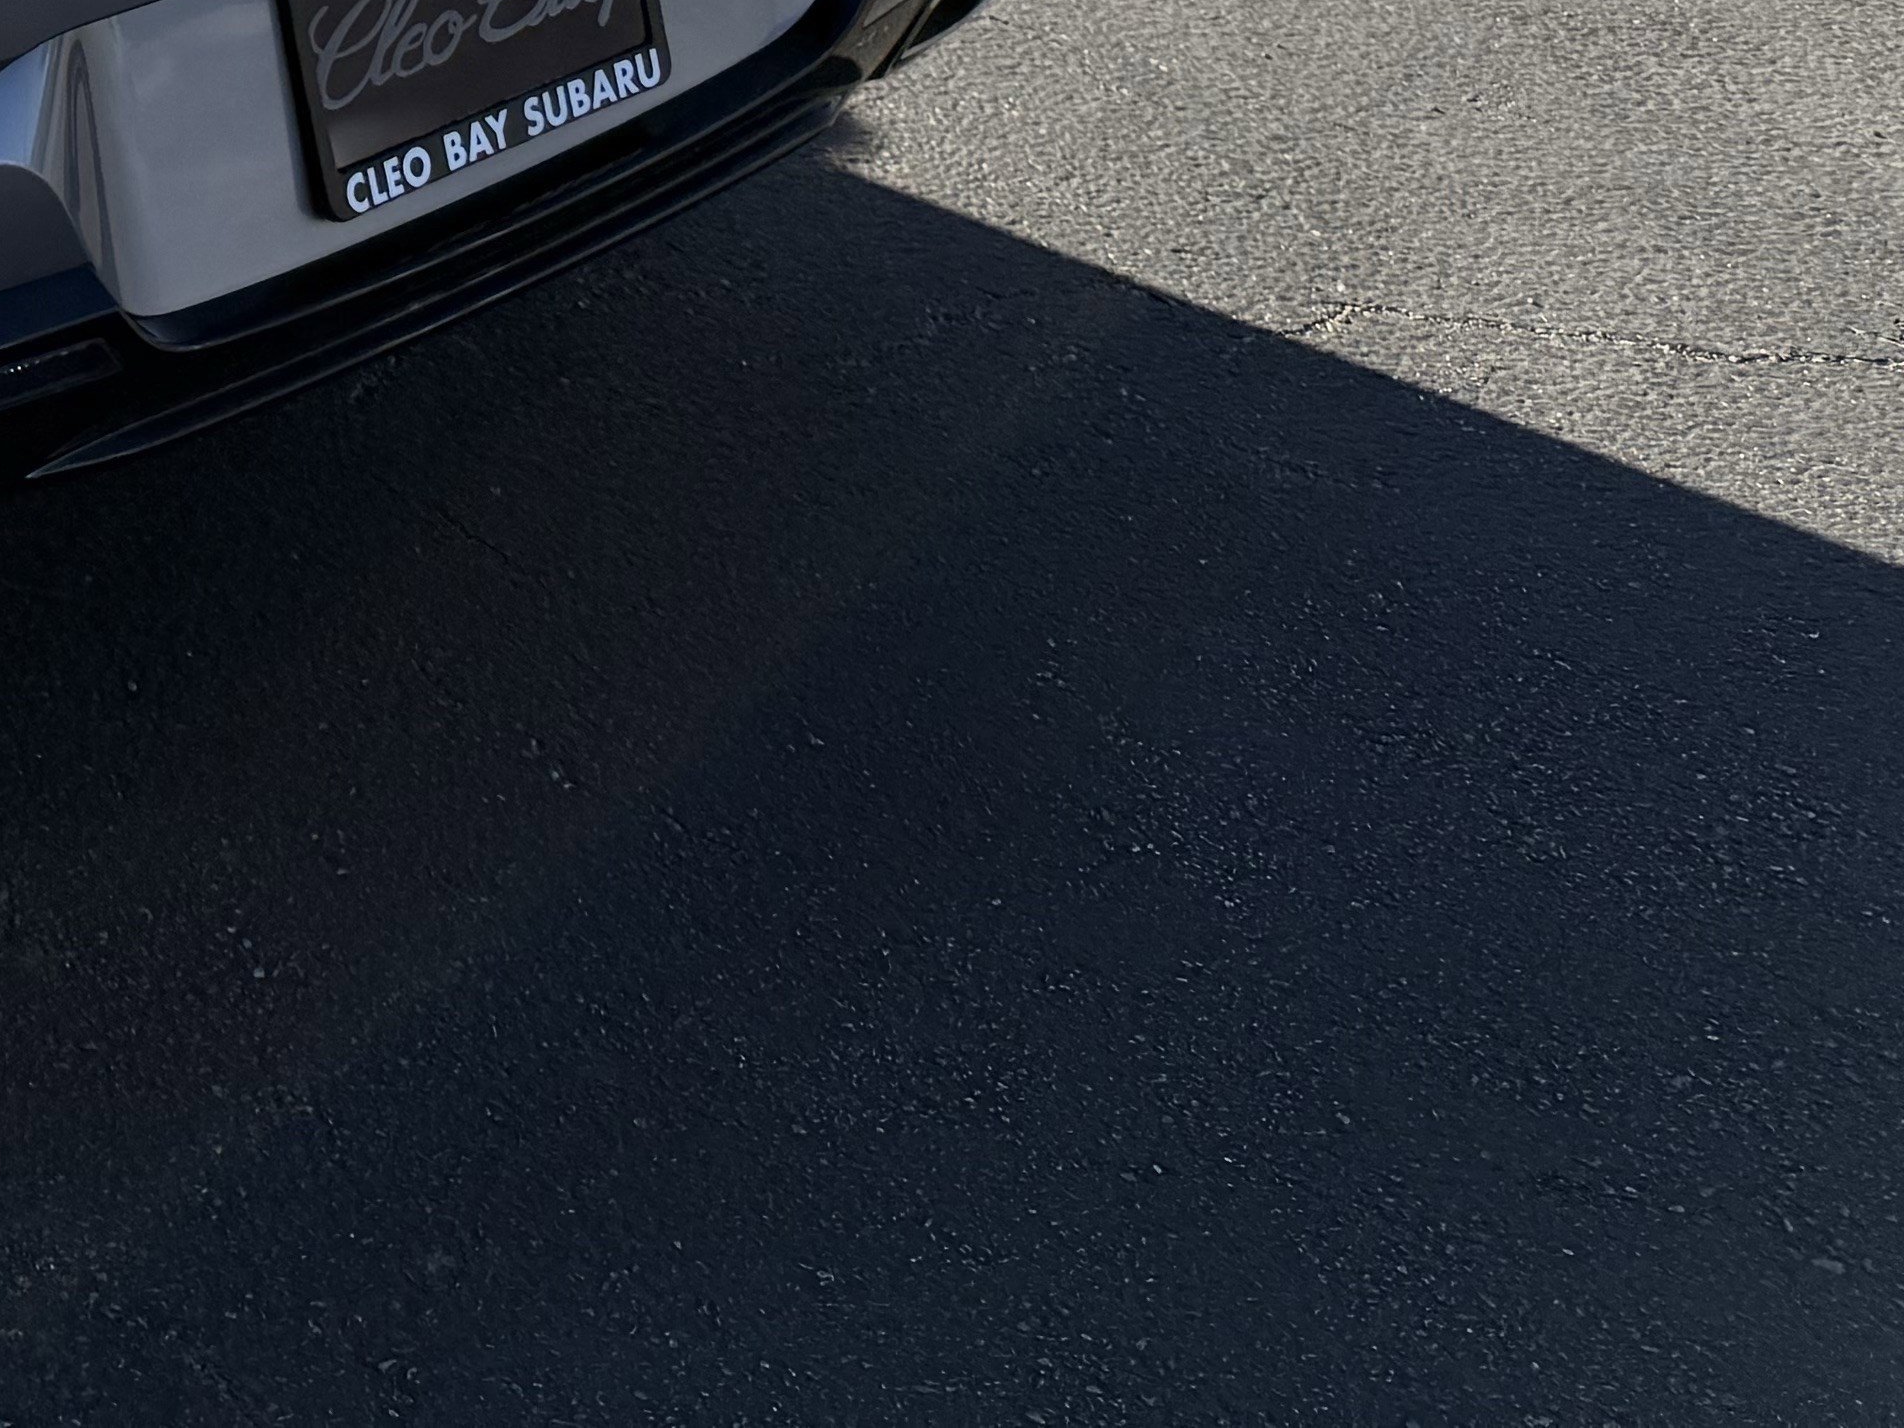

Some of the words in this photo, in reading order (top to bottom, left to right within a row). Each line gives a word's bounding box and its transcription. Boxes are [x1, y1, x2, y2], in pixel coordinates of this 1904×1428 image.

[346, 146, 432, 213] CLEO
[443, 109, 508, 171] BAY
[523, 48, 661, 138] SUBARU
